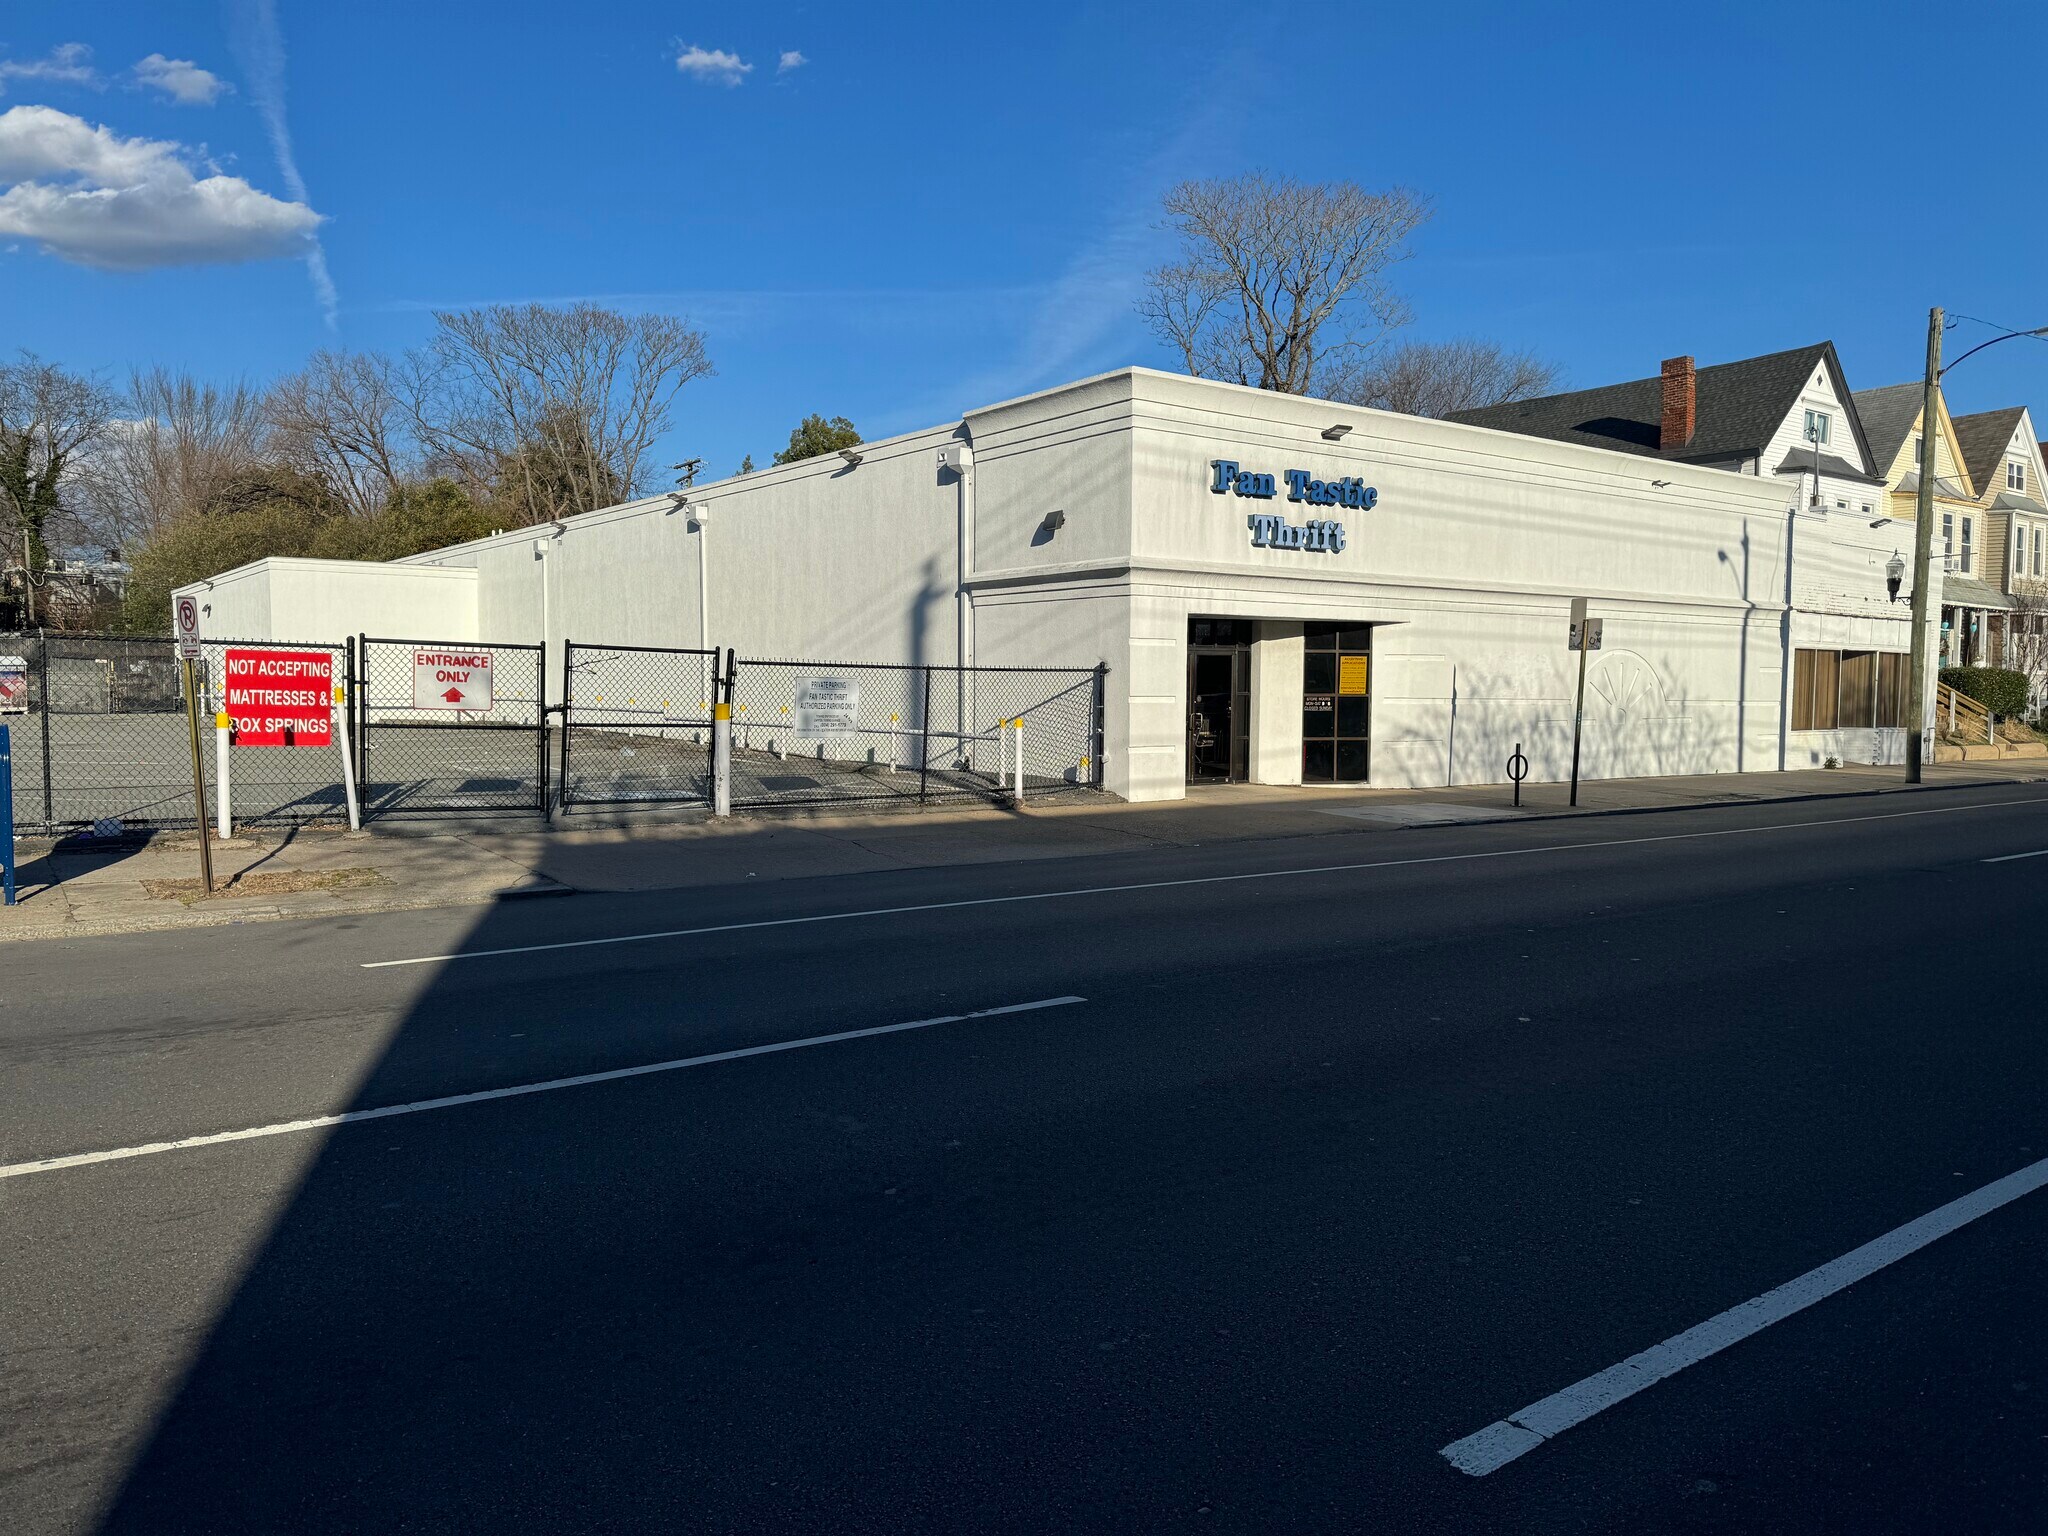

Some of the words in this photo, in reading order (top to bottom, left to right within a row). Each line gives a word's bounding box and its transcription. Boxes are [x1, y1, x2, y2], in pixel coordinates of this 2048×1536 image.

[1210, 459, 1277, 500] Fan
[1284, 468, 1378, 511] Tastic
[1247, 514, 1346, 554] Thrift
[229, 659, 256, 675] NOT
[258, 660, 330, 677] ACCEPTING
[417, 654, 488, 668] ENTRANCE
[436, 670, 470, 683] ONLY
[811, 681, 828, 689] PRIVATE
[829, 681, 846, 689] PARKING
[230, 688, 316, 706] MATTRESSES
[319, 691, 328, 706] &
[834, 693, 848, 701] THRIFT
[827, 702, 844, 710] PARKING
[265, 718, 328, 733] SPRINGS
